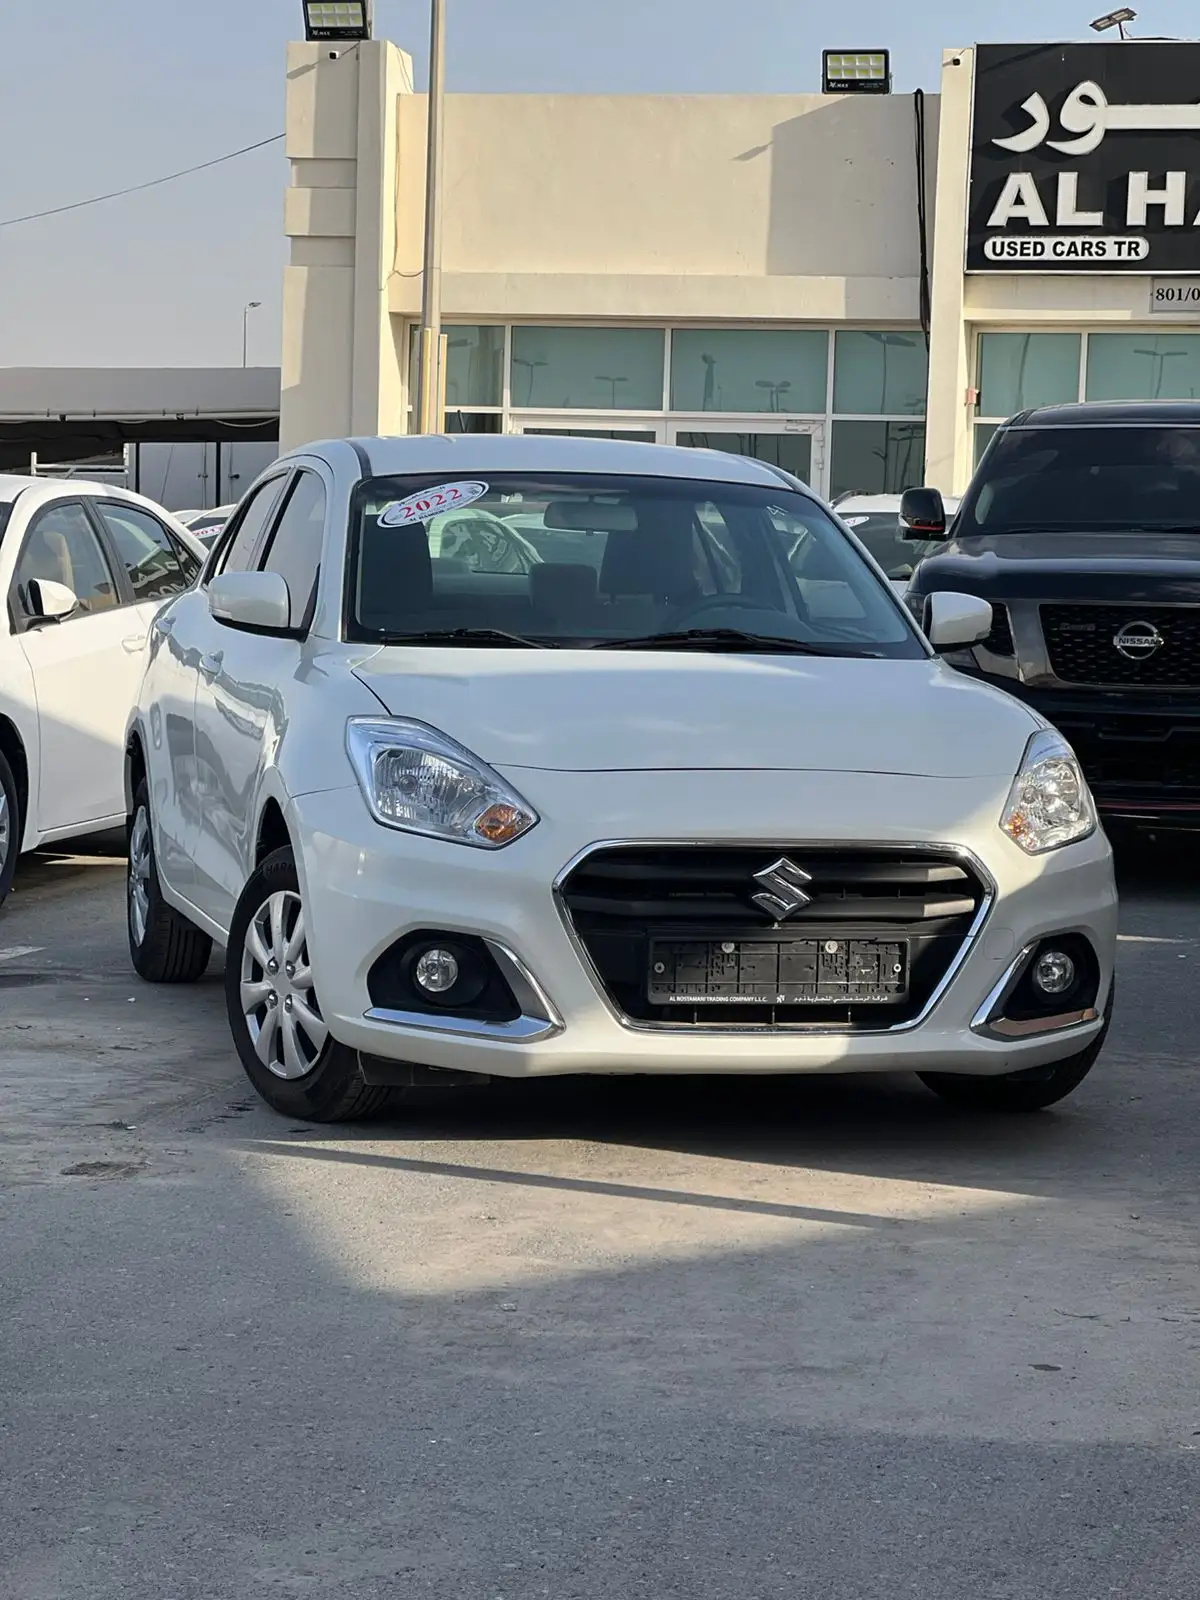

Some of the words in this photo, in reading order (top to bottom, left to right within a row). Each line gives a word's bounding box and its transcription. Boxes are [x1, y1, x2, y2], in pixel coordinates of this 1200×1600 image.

[986, 171, 1104, 227] AL
[1126, 171, 1200, 227] H
[991, 241, 1045, 257] USED
[1052, 240, 1107, 257] CARS
[1113, 241, 1141, 257] TR
[399, 488, 463, 519] 2022
[1119, 637, 1159, 645] NISSAN
